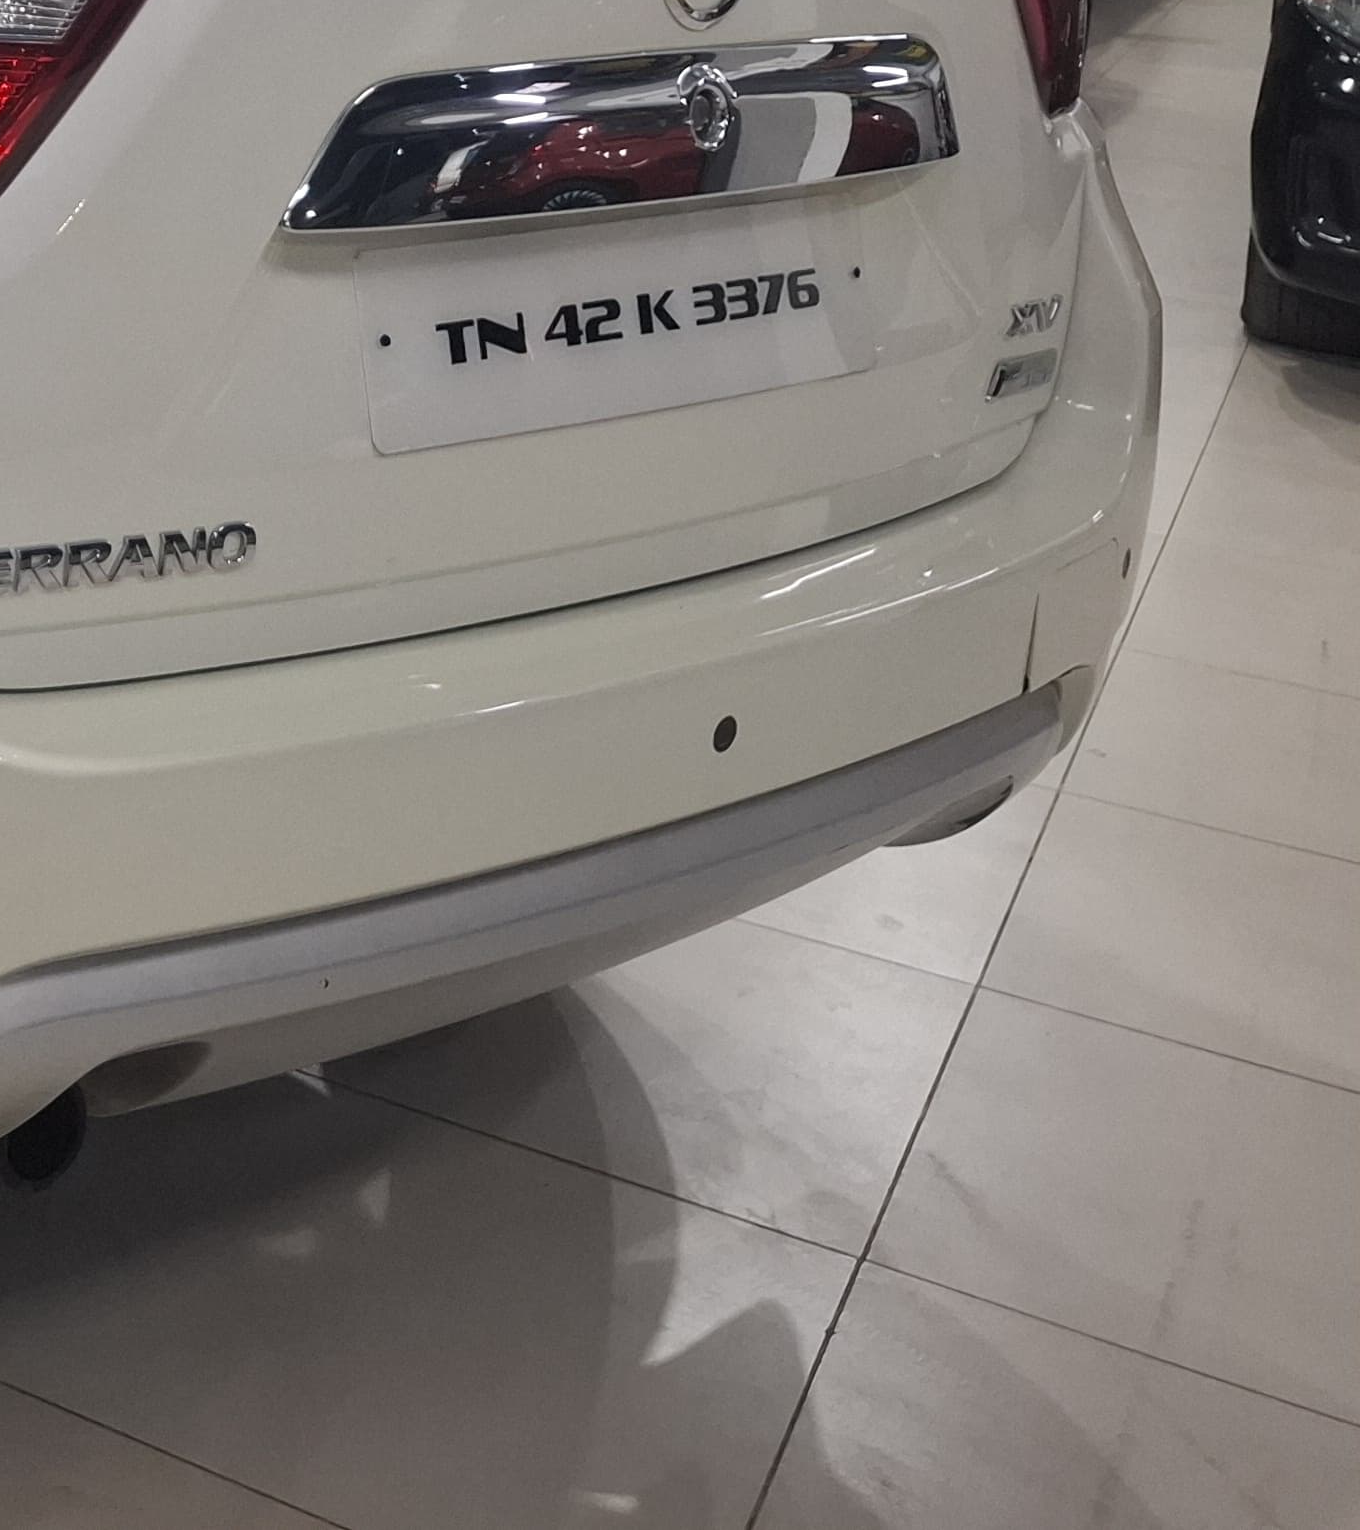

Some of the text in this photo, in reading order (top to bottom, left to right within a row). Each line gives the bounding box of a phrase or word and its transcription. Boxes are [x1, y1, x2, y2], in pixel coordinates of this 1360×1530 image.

[435, 268, 820, 365] TN 42 K 3376
